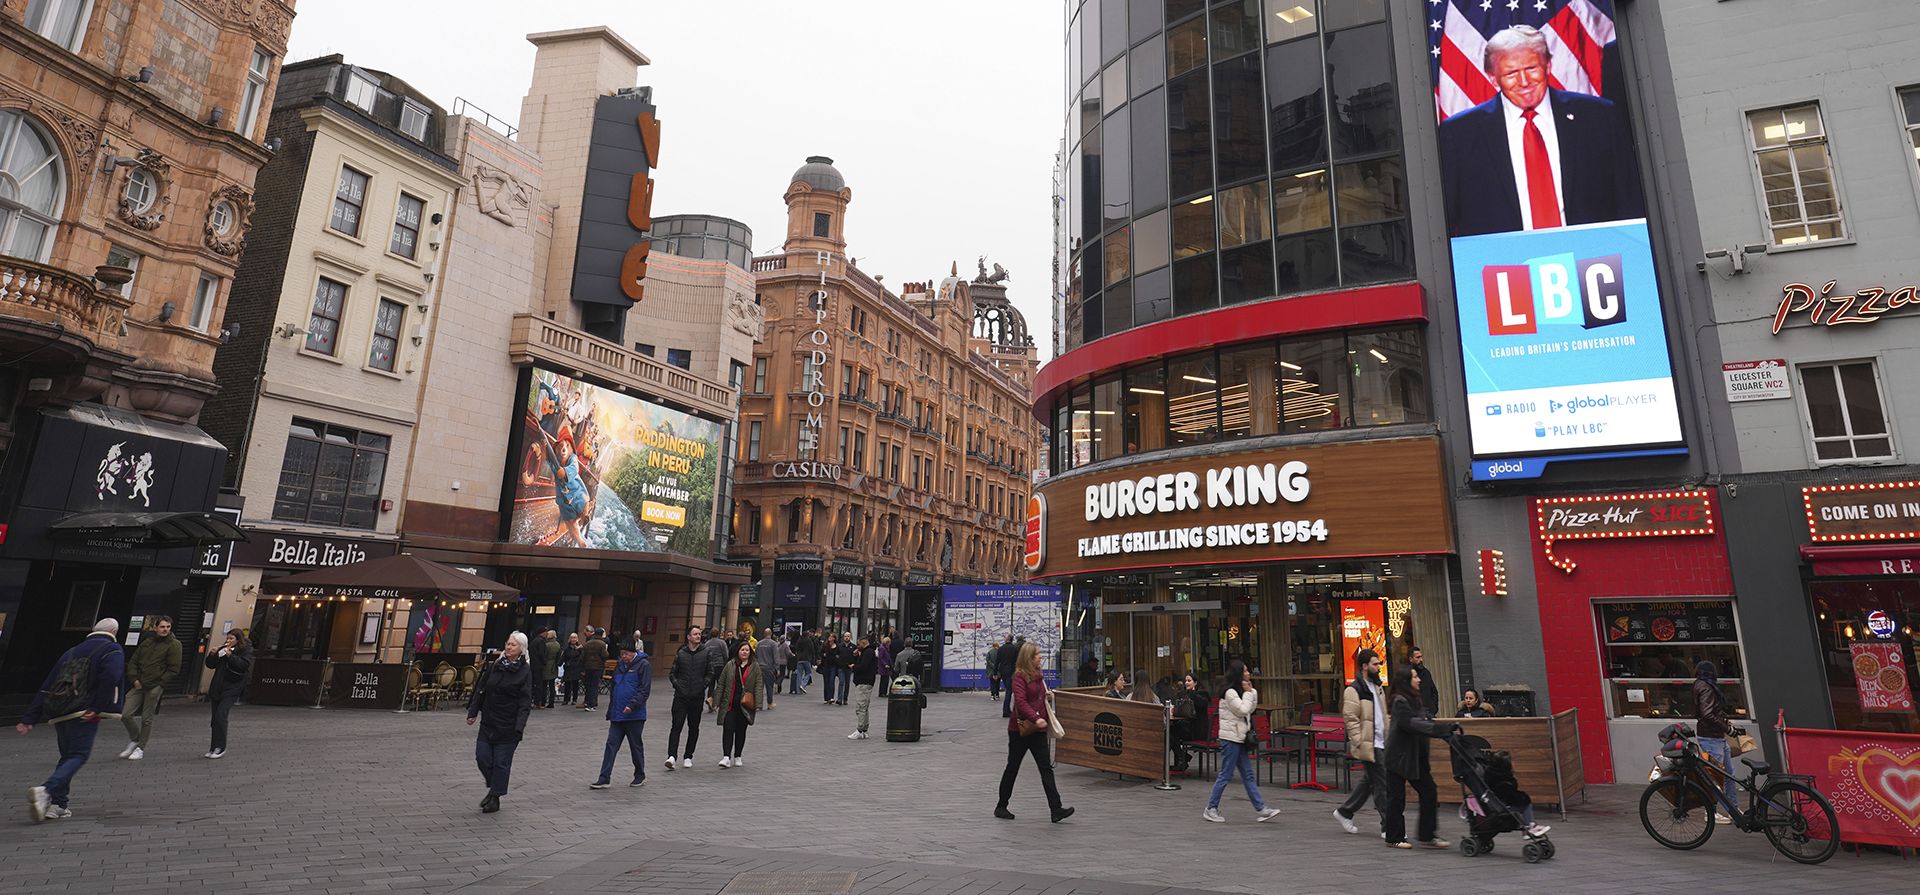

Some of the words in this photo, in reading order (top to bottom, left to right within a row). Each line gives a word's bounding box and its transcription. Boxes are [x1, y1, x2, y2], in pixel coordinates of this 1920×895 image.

[620, 111, 661, 302] VUE
[1497, 263, 1619, 327] LBC
[1772, 279, 1920, 335] Pizza
[311, 317, 331, 332] Grill
[806, 251, 831, 450] HIPPODROME
[1490, 344, 1526, 359] LEADING
[1527, 342, 1569, 355] BRITAIN'S
[1571, 335, 1636, 350] CONVERSATION
[1730, 371, 1772, 382] LEICESTER
[1732, 381, 1764, 391] SQUARE
[1764, 380, 1783, 388] WC2
[1506, 401, 1536, 415] RADIO
[635, 426, 705, 459] PADDINGTON
[648, 451, 660, 468] IN
[662, 453, 690, 475] PERU
[773, 462, 841, 480] CASINO
[1488, 461, 1523, 478] global
[658, 476, 665, 484] AT
[666, 477, 677, 486] VUE
[642, 483, 648, 494] 8
[649, 484, 690, 502] NOVEMBER
[1085, 471, 1200, 521] BURGER
[1206, 461, 1311, 508] KING
[646, 507, 665, 519] BOOK
[666, 509, 681, 520] NOW
[1548, 509, 1600, 529] Pizza
[1603, 507, 1643, 525] Hut
[1650, 505, 1701, 524] SLICE
[1821, 505, 1870, 521] COME
[1873, 503, 1898, 519] ON
[1902, 502, 1920, 517] IN
[1078, 533, 1121, 557] FLAME
[1122, 526, 1203, 553] GRILLING
[1206, 522, 1270, 547] SINCE
[1273, 519, 1328, 543] 1954
[270, 538, 316, 565] Bella
[320, 542, 366, 567] Italia
[299, 587, 324, 595] PIZZA
[336, 588, 363, 596] PASTA
[375, 589, 399, 597] GRILL
[470, 590, 481, 600] Bella
[481, 590, 493, 600] Italia
[1612, 603, 1635, 611] SLICE
[1648, 601, 1686, 610] SHARING
[1693, 600, 1727, 609] DRINKS
[911, 633, 919, 641] To
[921, 633, 933, 641] Let
[354, 673, 379, 686] Bella
[1859, 678, 1882, 691] DECK
[351, 686, 377, 699] Italia
[1863, 694, 1888, 708] HALLS
[1093, 723, 1122, 736] BURGER
[1093, 732, 1122, 749] KING
